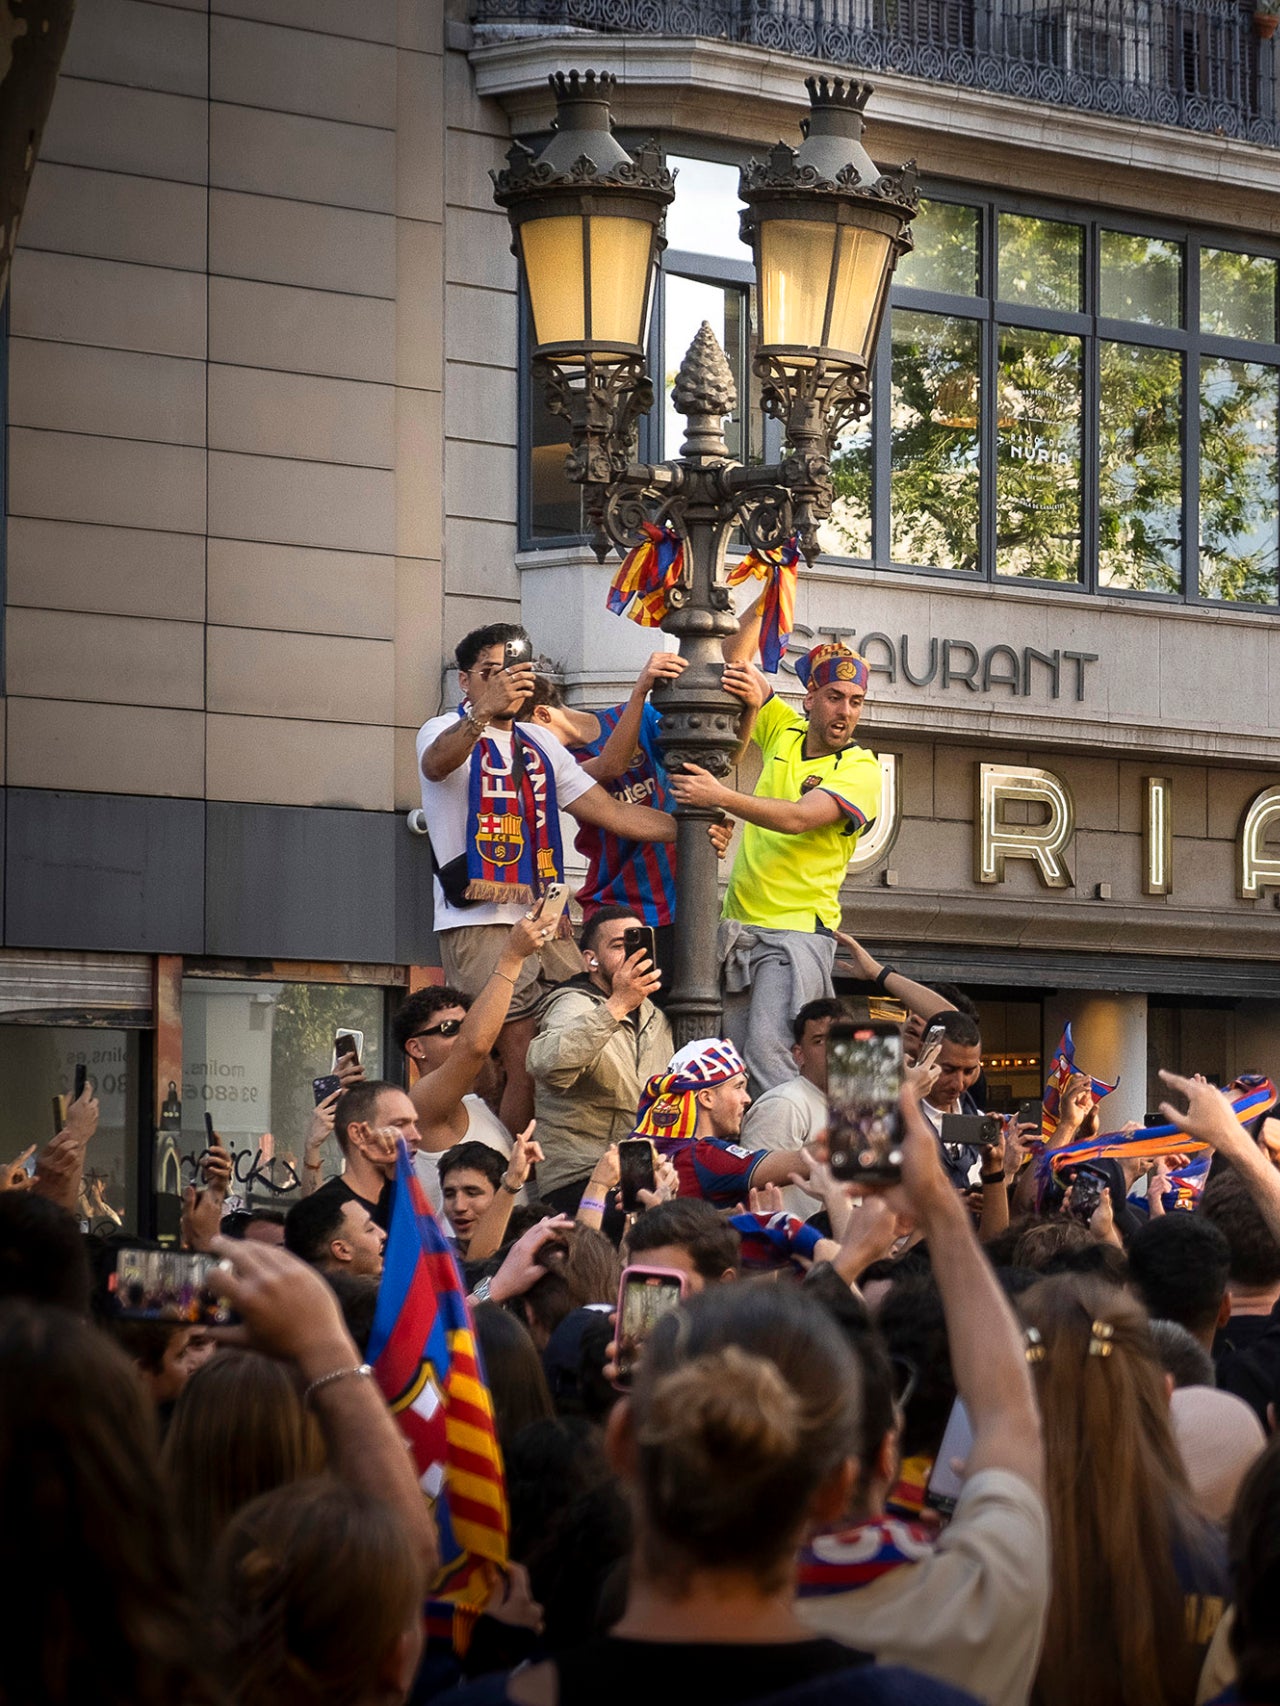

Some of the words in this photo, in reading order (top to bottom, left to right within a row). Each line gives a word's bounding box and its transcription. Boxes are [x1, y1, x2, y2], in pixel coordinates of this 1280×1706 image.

[1011, 445, 1069, 465] NURIA
[754, 621, 1099, 701] STAURANT
[614, 777, 656, 804] uten
[491, 834, 511, 843] FCB
